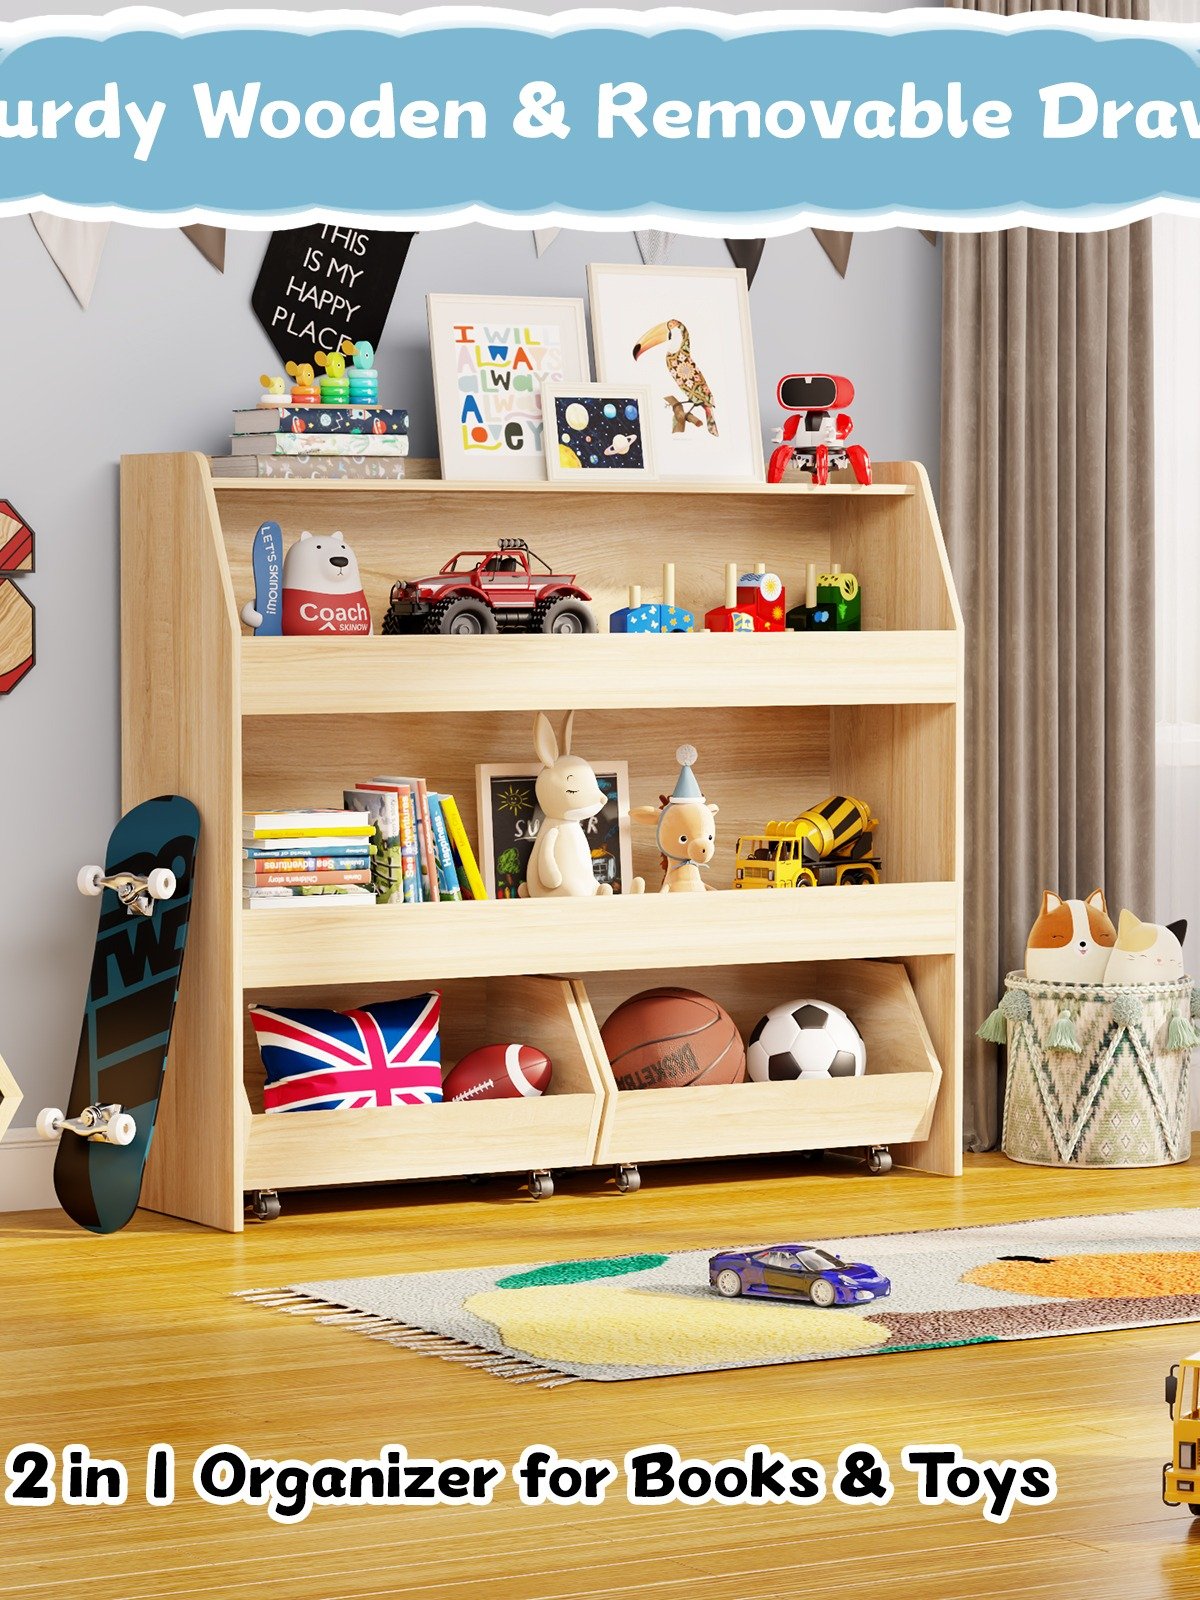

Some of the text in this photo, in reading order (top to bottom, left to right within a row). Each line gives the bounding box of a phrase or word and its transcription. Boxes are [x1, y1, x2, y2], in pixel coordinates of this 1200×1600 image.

[303, 247, 364, 288] IS MY
[286, 275, 361, 323] HAPPY
[271, 306, 352, 357] PLACE
[453, 325, 475, 343] I
[261, 526, 277, 563] LET'S
[299, 603, 368, 622] Coach
[338, 623, 368, 632] SKINOW
[434, 815, 452, 867] Happiness
[263, 860, 315, 870] adventures
[316, 860, 335, 870] Sea
[405, 856, 414, 877] Sea
